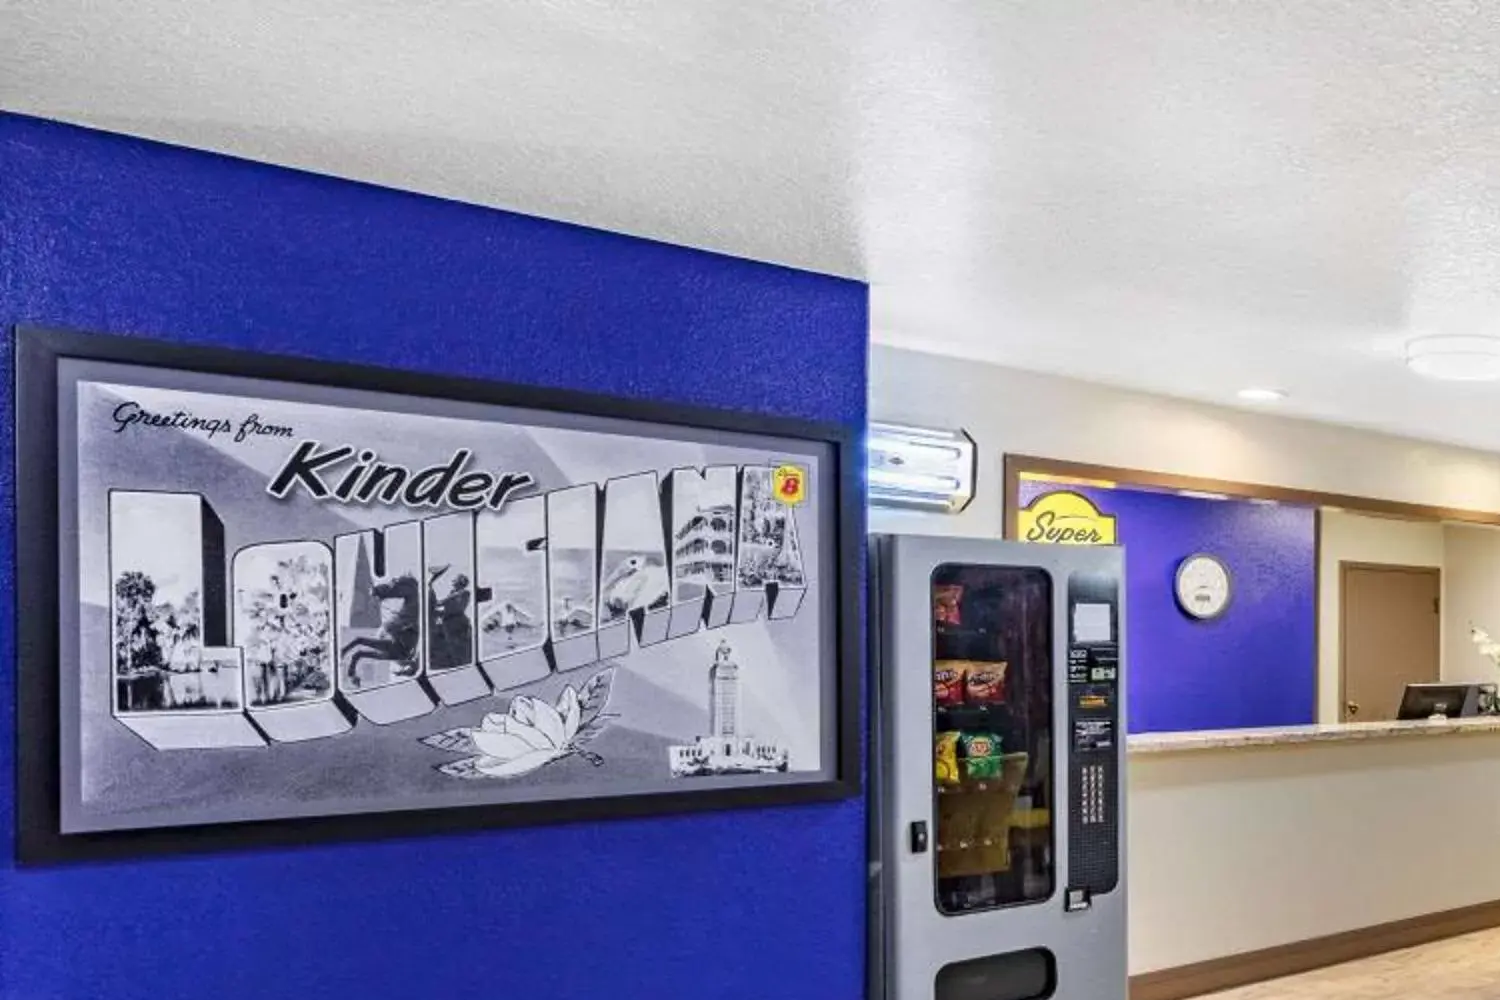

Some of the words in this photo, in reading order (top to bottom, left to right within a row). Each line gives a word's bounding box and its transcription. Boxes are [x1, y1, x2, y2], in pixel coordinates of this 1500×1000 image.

[112, 401, 231, 438] Greetings
[234, 414, 295, 441] from
[267, 440, 535, 511] Kinder
[1026, 510, 1102, 542] Super
